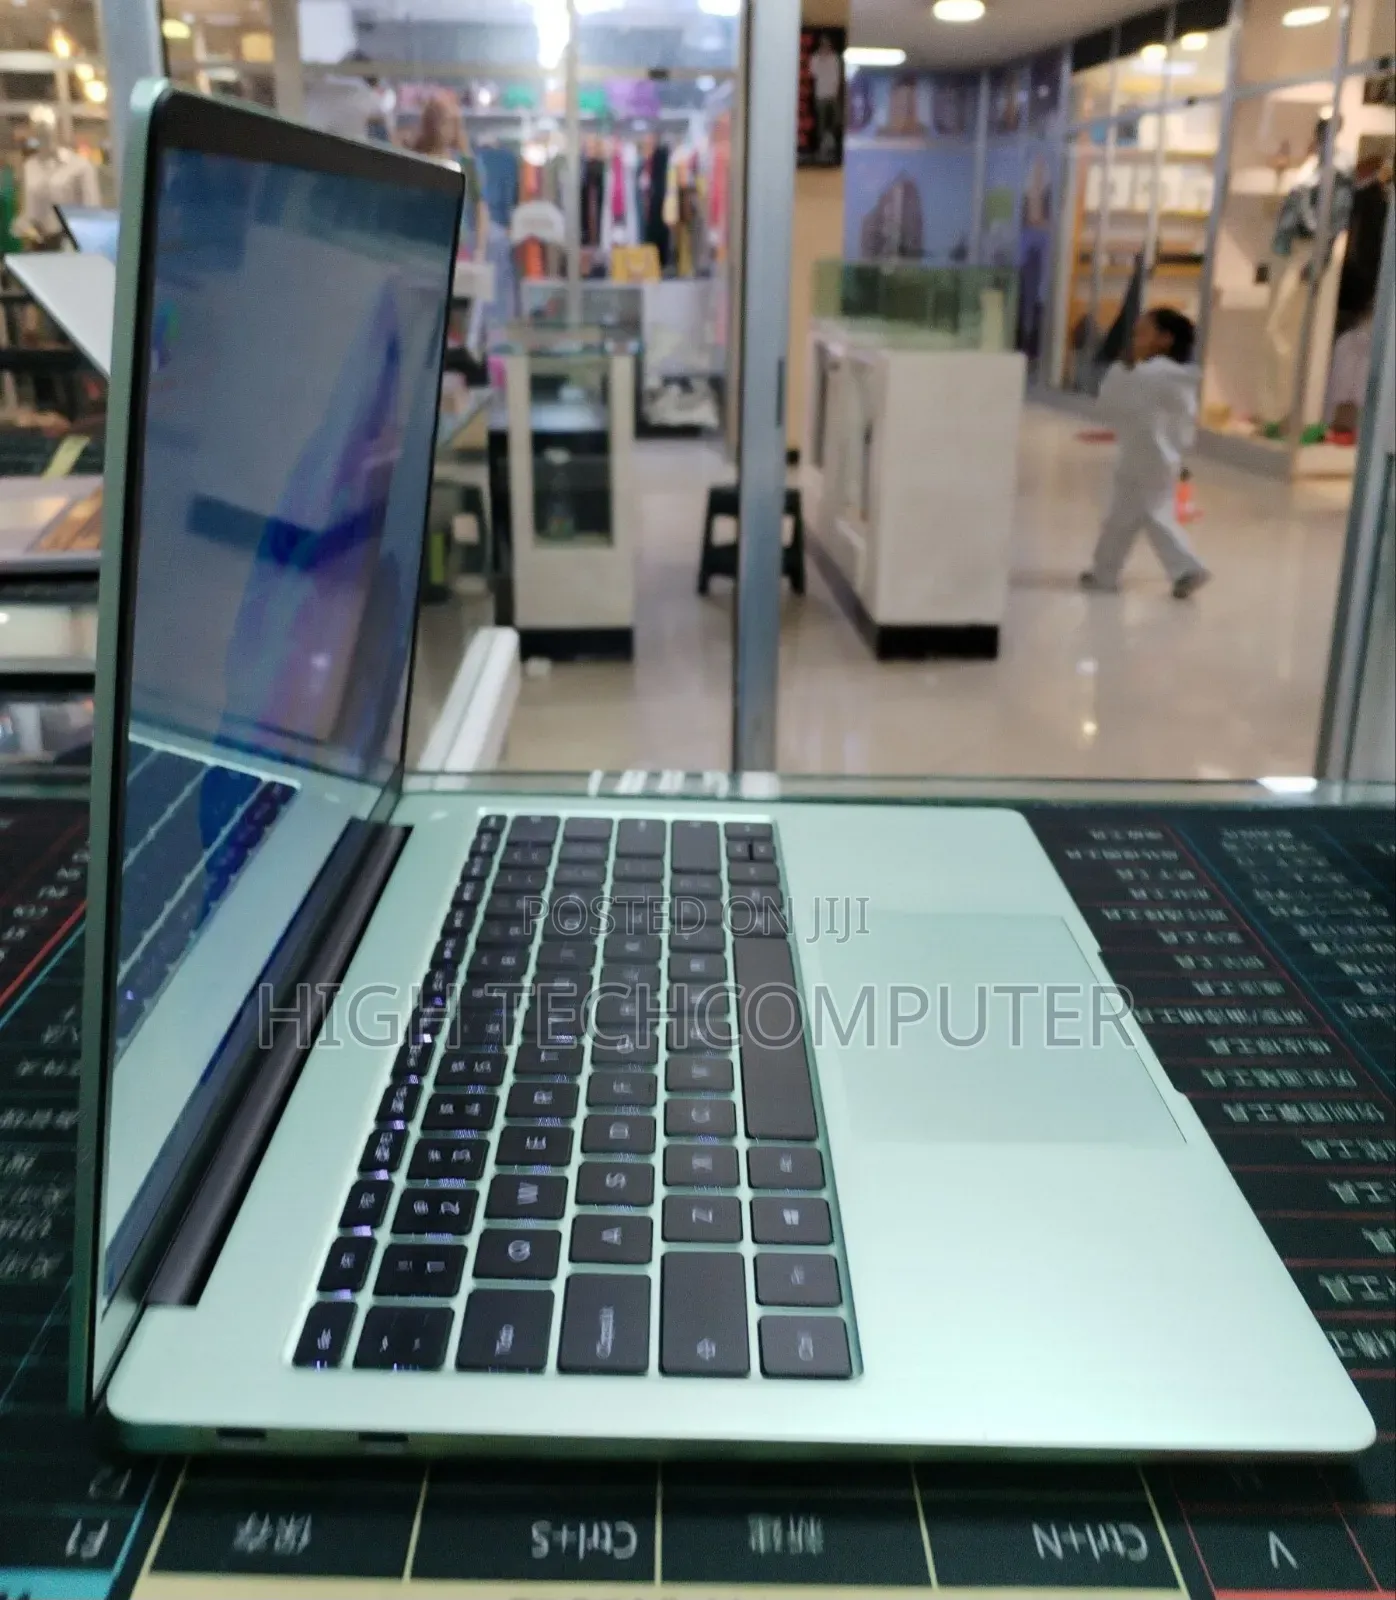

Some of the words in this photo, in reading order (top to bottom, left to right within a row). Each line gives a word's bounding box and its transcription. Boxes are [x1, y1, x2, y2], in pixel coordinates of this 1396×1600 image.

[530, 1518, 638, 1560] Ctrl+S
[1031, 1521, 1148, 1564] Ctrl+N
[1268, 1530, 1299, 1570] V
